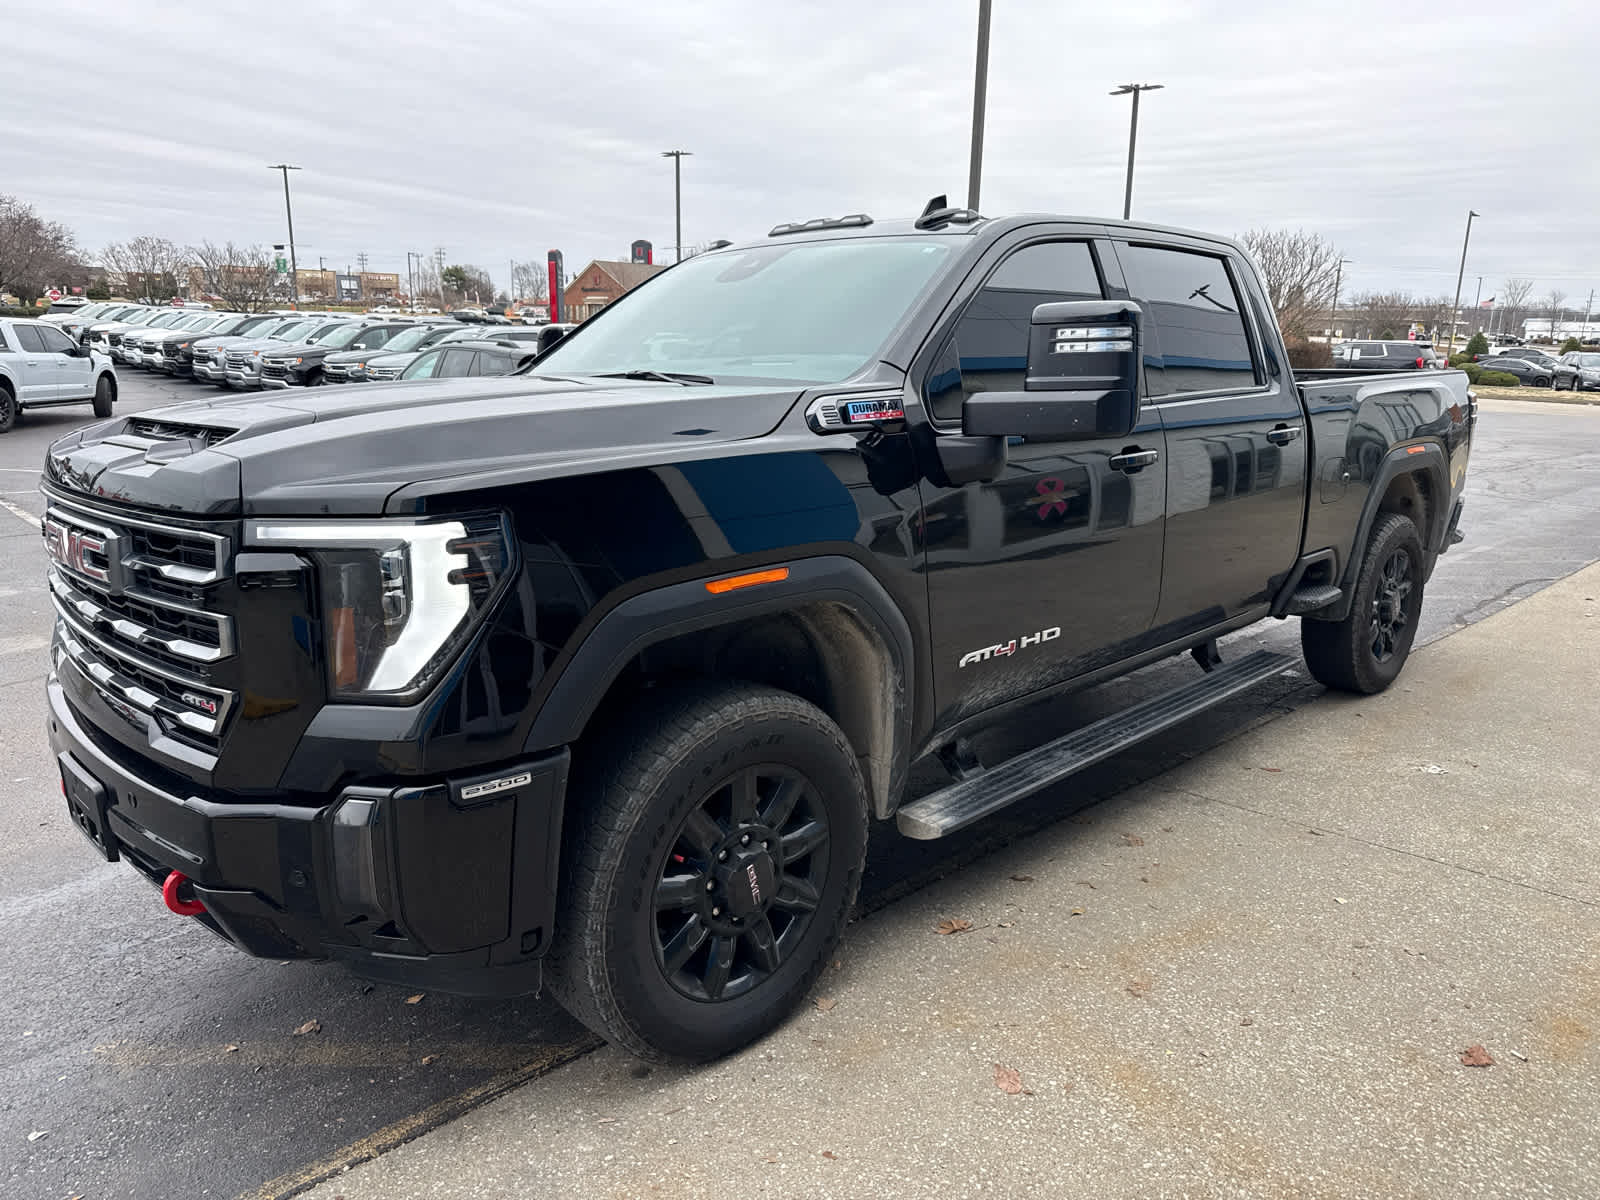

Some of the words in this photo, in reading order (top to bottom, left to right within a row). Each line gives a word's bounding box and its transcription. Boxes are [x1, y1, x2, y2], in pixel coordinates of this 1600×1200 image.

[851, 401, 900, 414] DURAMAX
[46, 519, 111, 583] GMC
[960, 639, 1017, 668] AT4
[1020, 626, 1061, 649] HD
[180, 693, 217, 714] AT4
[461, 771, 532, 799] 2500
